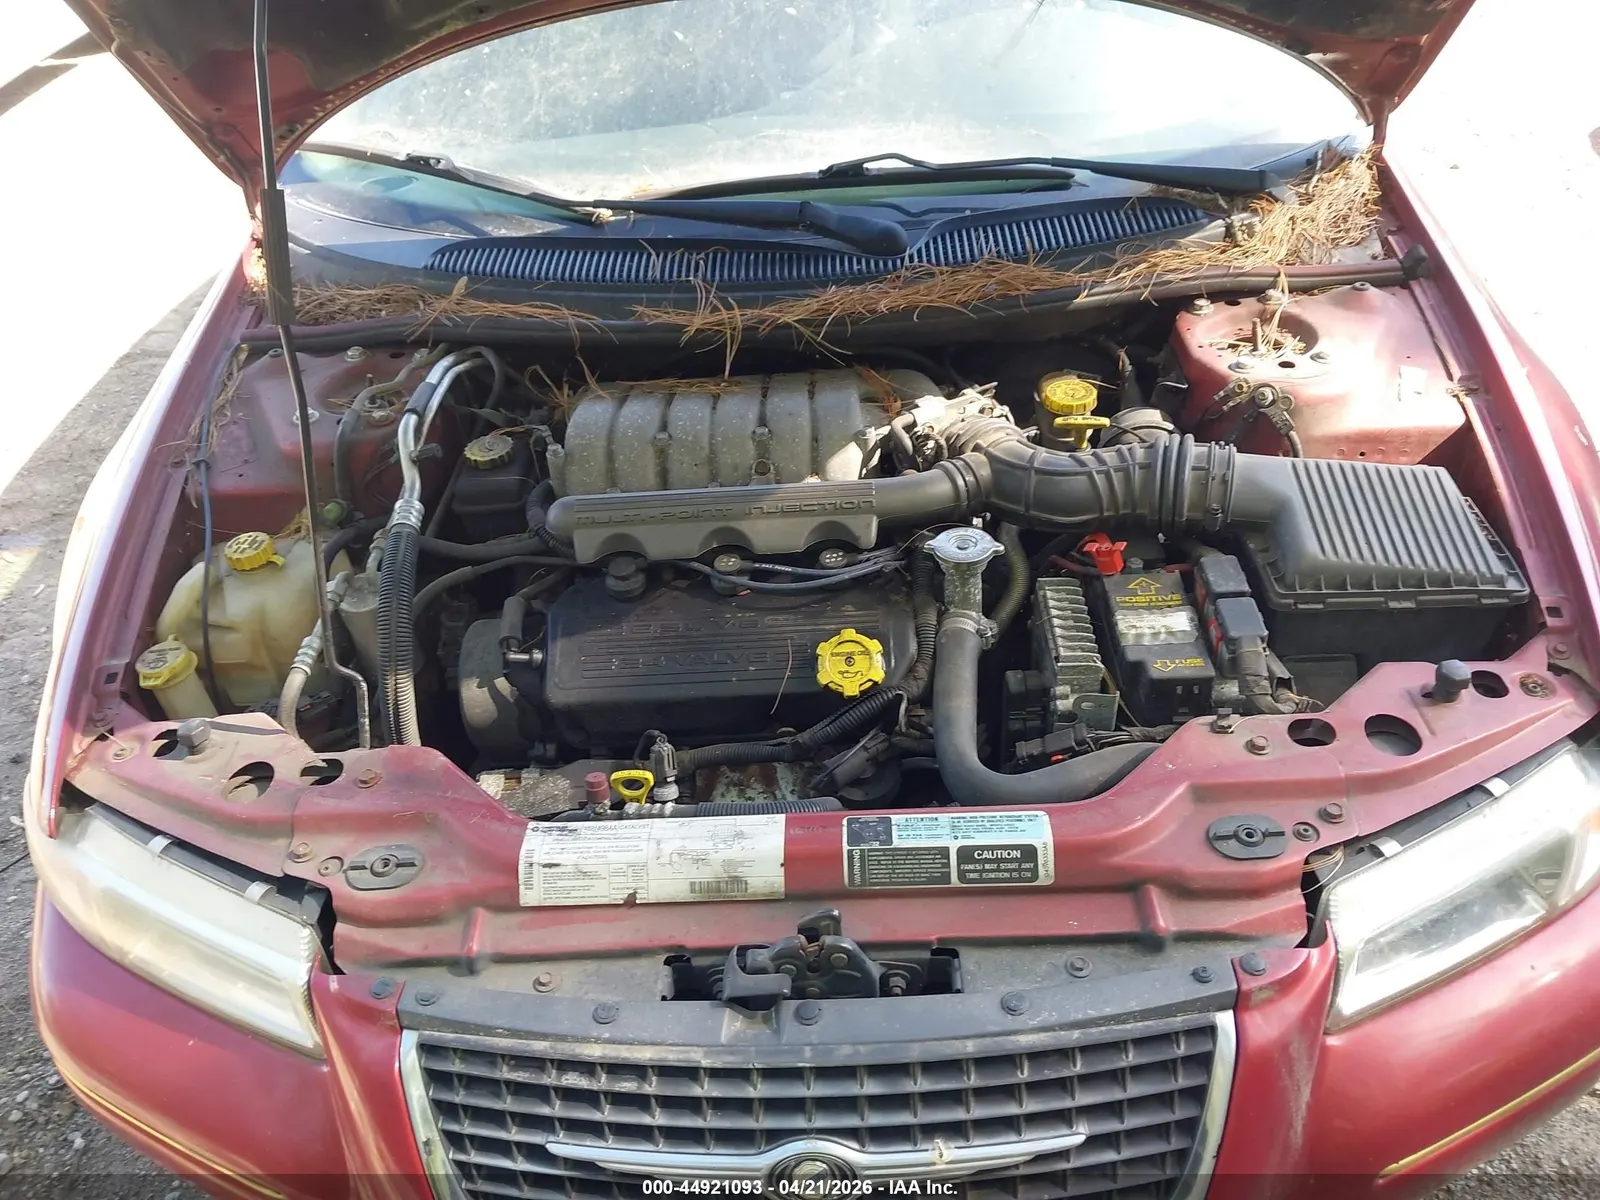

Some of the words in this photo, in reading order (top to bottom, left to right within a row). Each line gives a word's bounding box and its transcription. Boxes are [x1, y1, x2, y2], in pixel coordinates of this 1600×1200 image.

[745, 498, 877, 516] INJECTION
[1115, 594, 1183, 603] POSITIVE
[973, 849, 1022, 860] CAUTION
[852, 849, 862, 886] WARNING
[982, 871, 1010, 879] IGNITION
